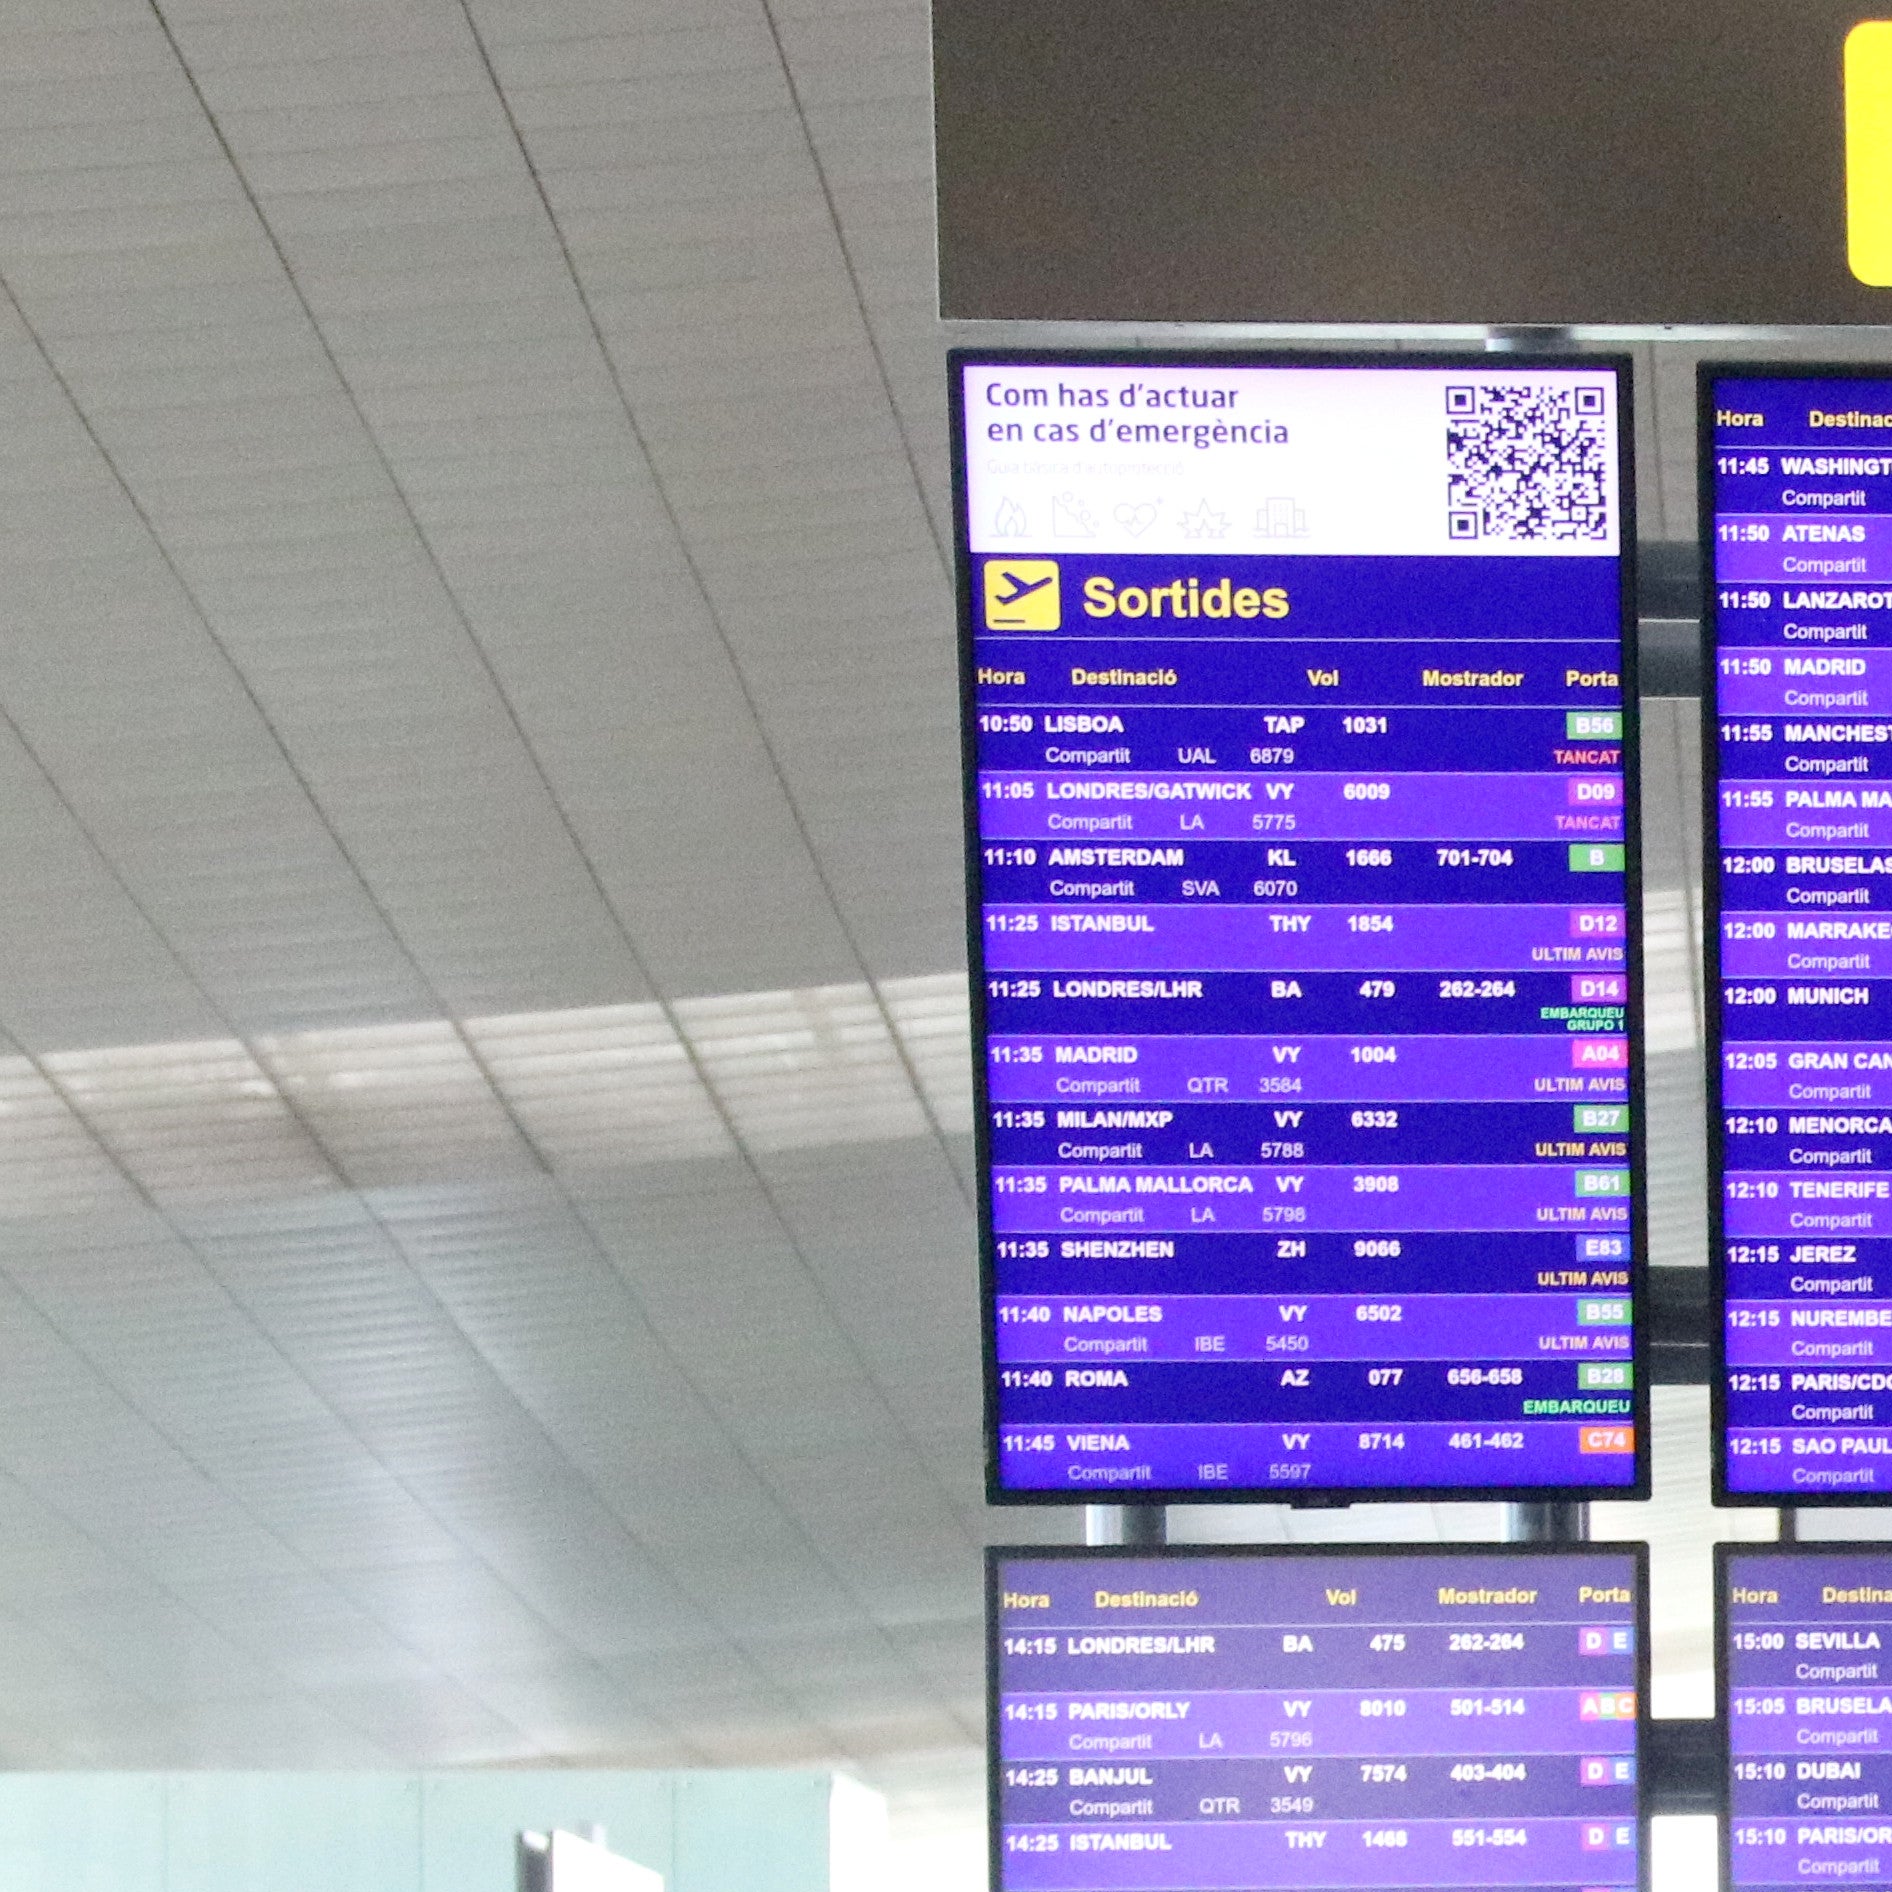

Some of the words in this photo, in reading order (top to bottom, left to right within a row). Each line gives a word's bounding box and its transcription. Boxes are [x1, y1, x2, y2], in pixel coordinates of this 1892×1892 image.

[986, 383, 1048, 406] Com
[1059, 383, 1109, 407] has
[1717, 410, 1764, 426] Hora
[988, 423, 1022, 441] en
[1034, 424, 1079, 442] cas
[1718, 457, 1769, 474] 11:45
[1782, 489, 1866, 509] Compartit
[1084, 577, 1289, 618] Sortides
[978, 668, 1025, 684] Hora
[1071, 668, 1177, 685] Destinació
[1307, 670, 1339, 686] Vol
[1422, 670, 1524, 686] Mostrador
[1566, 670, 1619, 686] Porta
[980, 715, 1033, 732] 10:50
[1045, 715, 1124, 733] LISBOA
[1264, 716, 1305, 733] TAP
[1343, 717, 1387, 733] 1031
[1575, 716, 1614, 734] B56
[1045, 747, 1130, 766] Compartit
[1178, 748, 1216, 764] UAL
[1250, 747, 1294, 764] 6879
[1554, 750, 1620, 764] TANCAT
[1729, 1374, 1781, 1391] 12:15
[1004, 1434, 1055, 1451] 11:45
[1067, 1434, 1130, 1451] VIENA
[1282, 1433, 1310, 1450] VY
[1359, 1433, 1405, 1449] 8714
[1449, 1432, 1523, 1449] 461-462
[1587, 1431, 1626, 1448] C74
[1003, 1593, 1050, 1608] Hora
[1095, 1591, 1199, 1608] Destinació
[1326, 1589, 1357, 1605] Vol
[1438, 1588, 1537, 1604] Mostrador
[1579, 1586, 1631, 1603] Porta
[1732, 1588, 1778, 1603] Hora
[1005, 1637, 1057, 1654] 14:15
[1068, 1636, 1215, 1654] LONDRES/LHR
[1283, 1635, 1313, 1652] BA
[1370, 1634, 1405, 1651] 475
[1449, 1633, 1524, 1651] 262-264
[1735, 1763, 1786, 1780] 15:10
[1797, 1762, 1861, 1780] DUBAI
